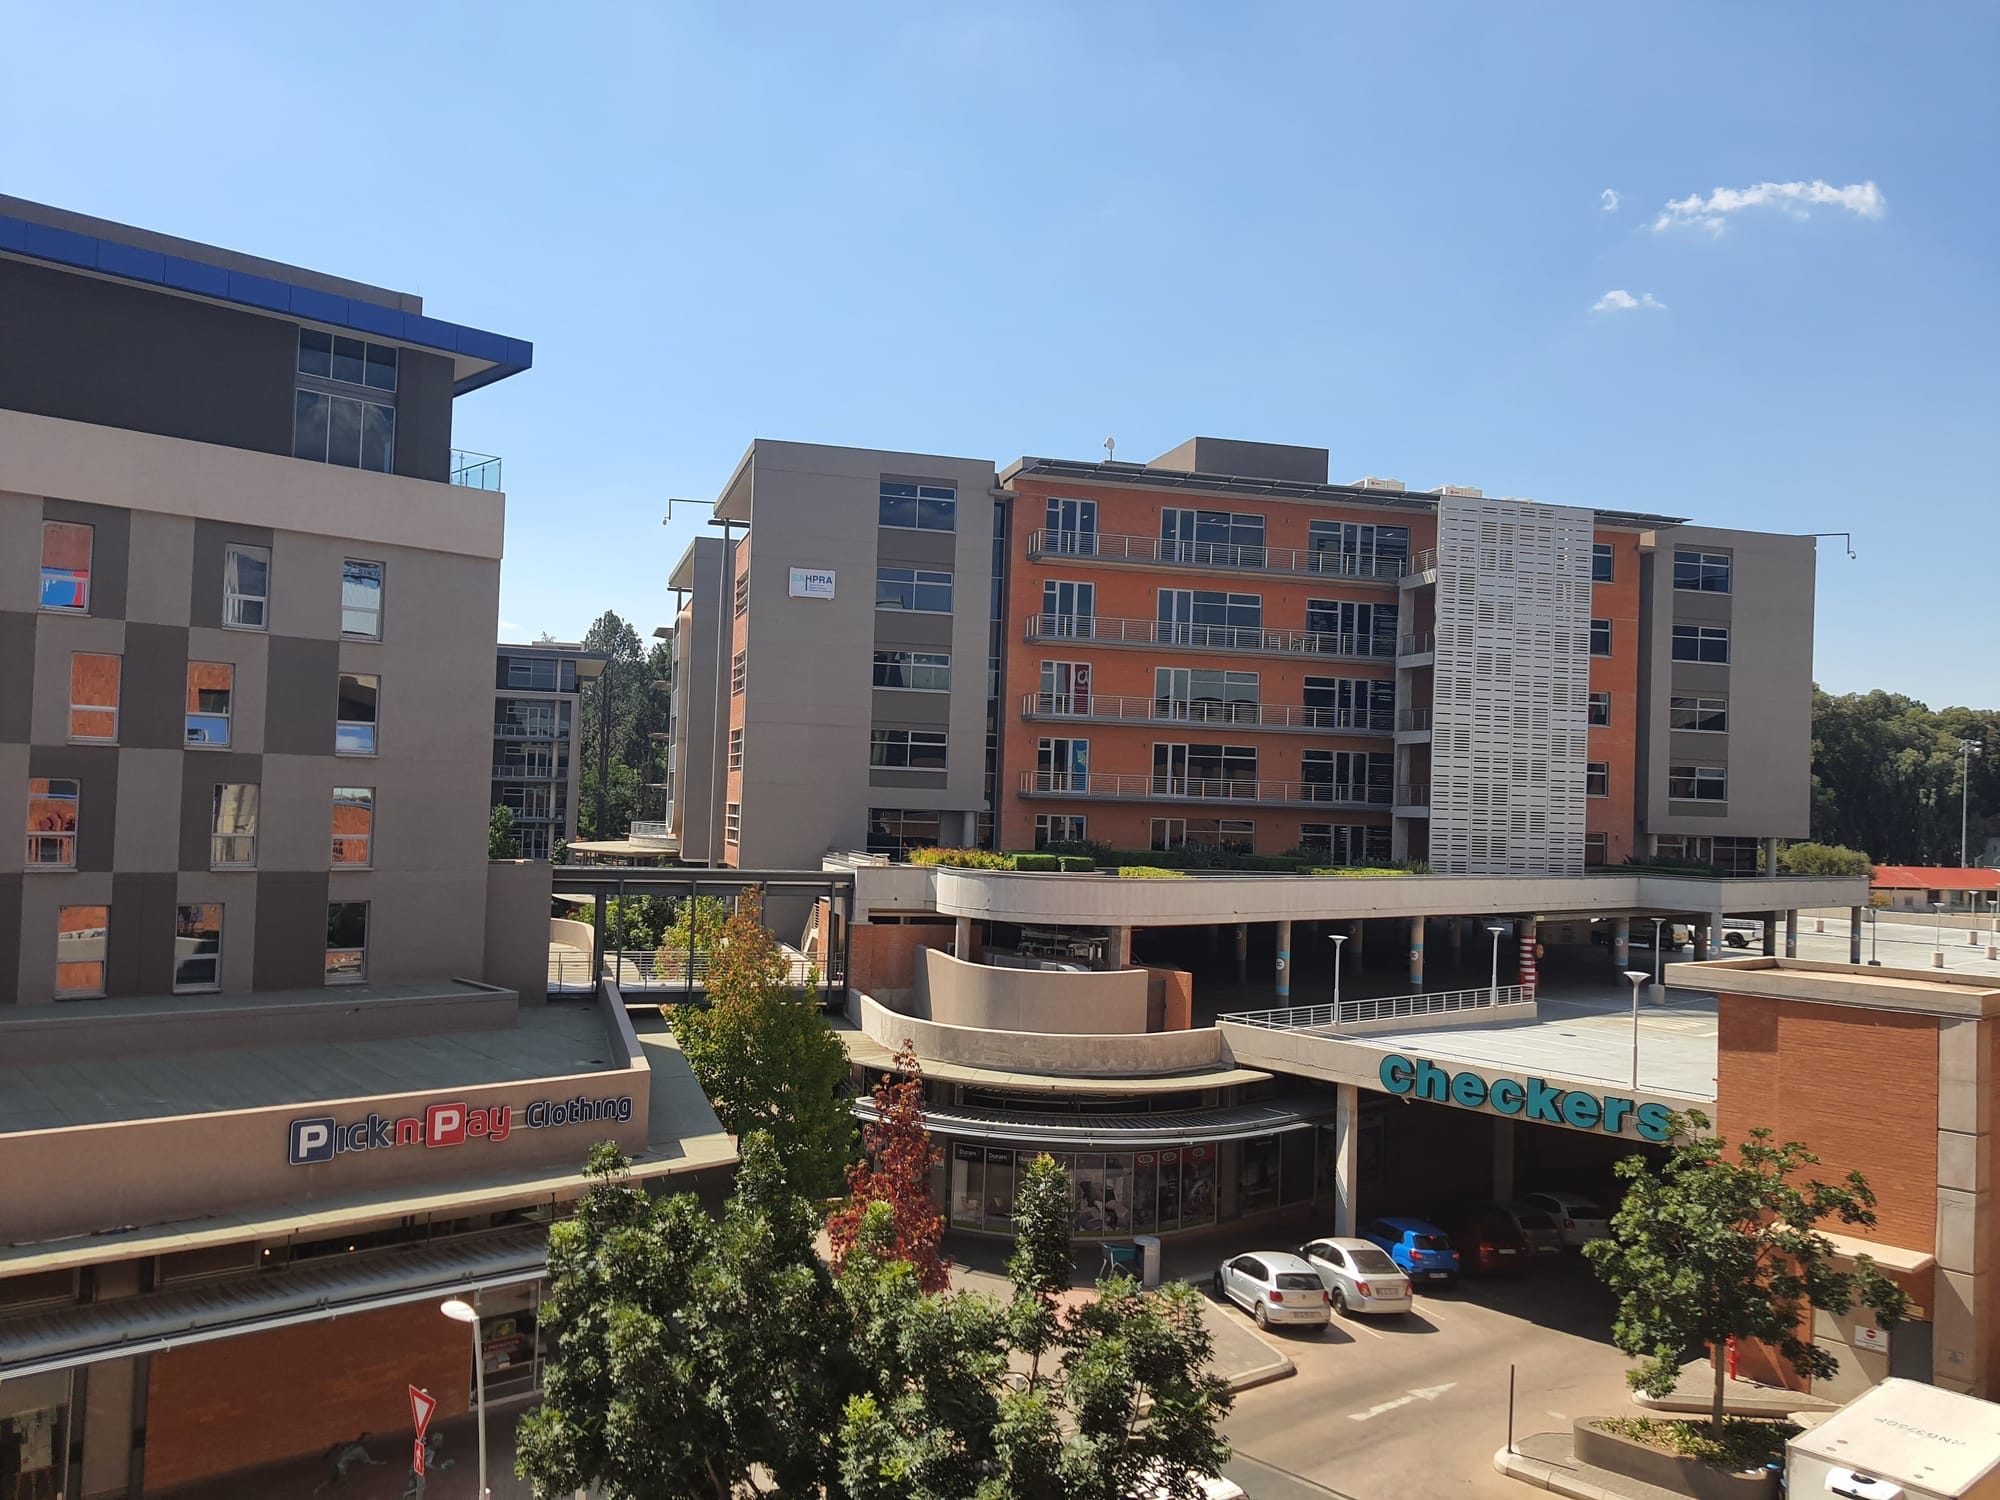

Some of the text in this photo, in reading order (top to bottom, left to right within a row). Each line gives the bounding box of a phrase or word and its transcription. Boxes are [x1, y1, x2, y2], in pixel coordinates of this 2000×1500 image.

[289, 1115, 391, 1166] Pick
[425, 1102, 512, 1148] Pay
[526, 1096, 633, 1128] Clothing
[1379, 1054, 1674, 1142] Checkers
